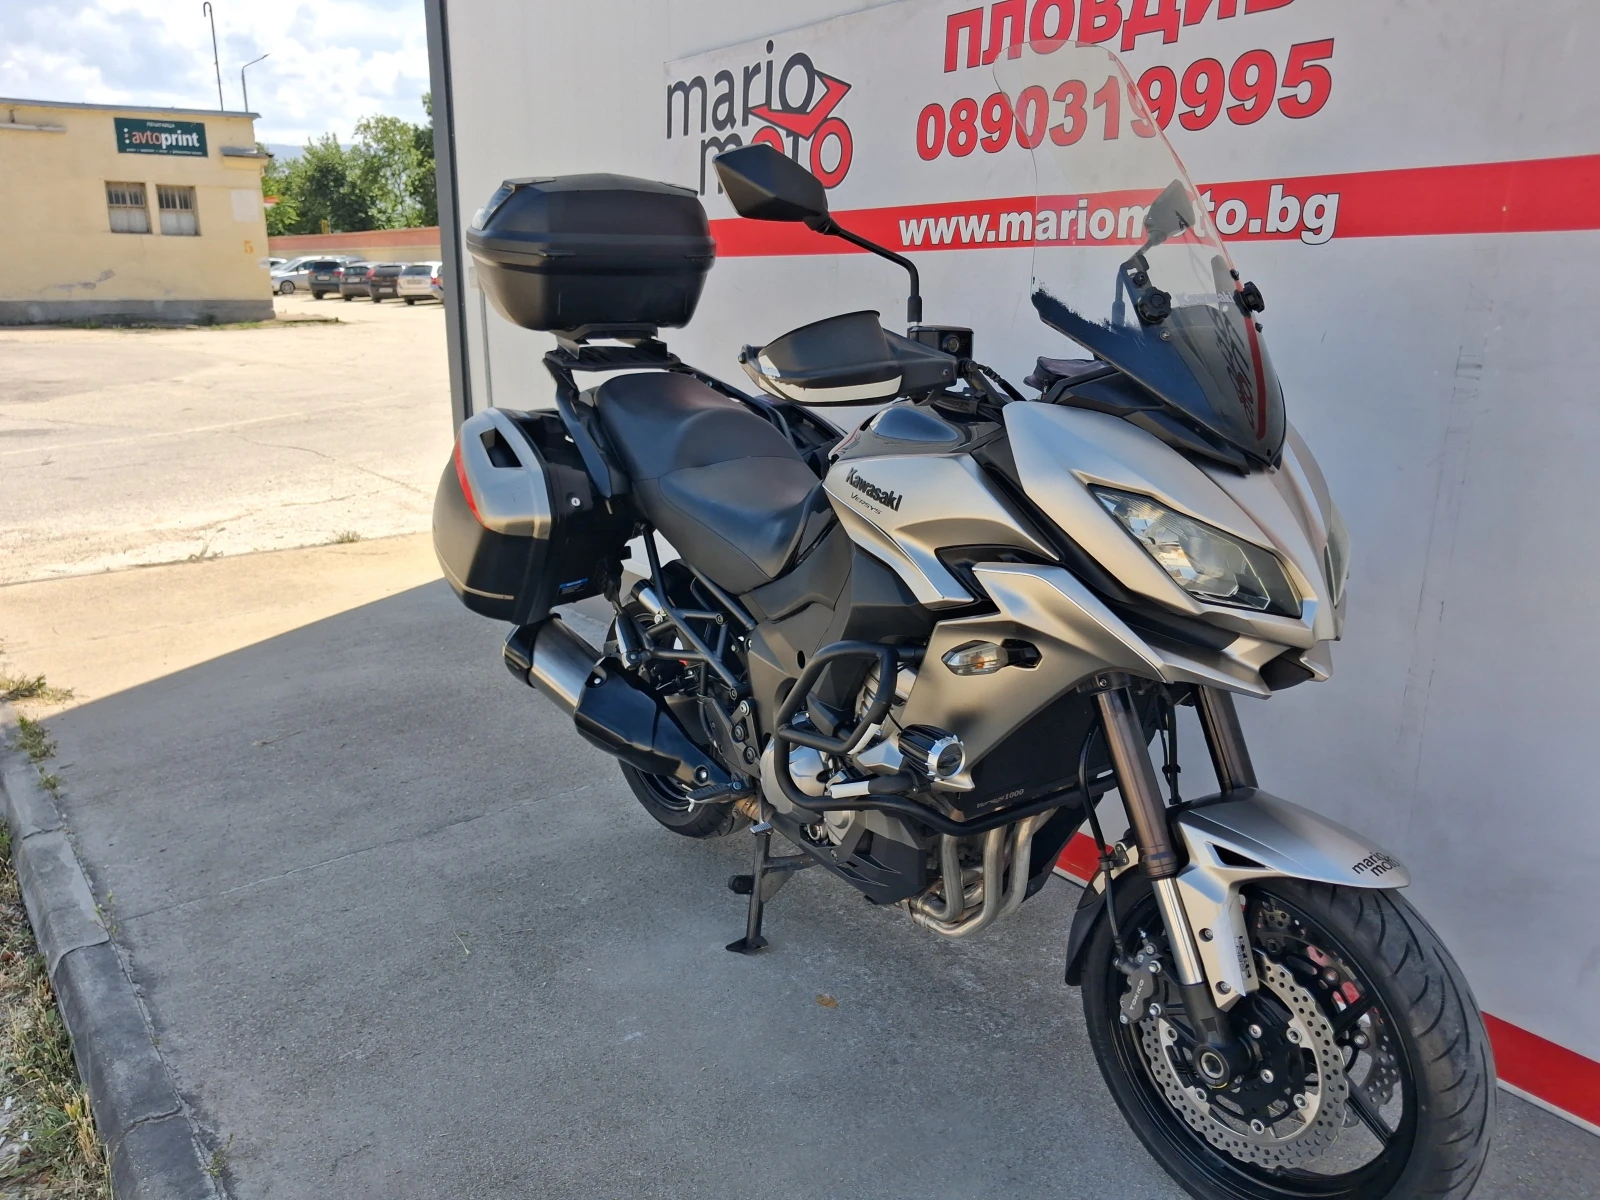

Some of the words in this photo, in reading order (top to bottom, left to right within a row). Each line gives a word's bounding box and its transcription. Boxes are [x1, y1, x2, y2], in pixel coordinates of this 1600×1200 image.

[943, 0, 1295, 73] ПЛОВД
[666, 39, 815, 140] mario
[916, 38, 1335, 161] 0890319995
[131, 129, 200, 150] avtoprint
[898, 184, 1340, 246] www.mariomto.bg
[244, 240, 255, 255] 5
[845, 467, 903, 512] Kawasaki
[1351, 851, 1388, 875] mario
[1129, 979, 1145, 1011] TOKICO
